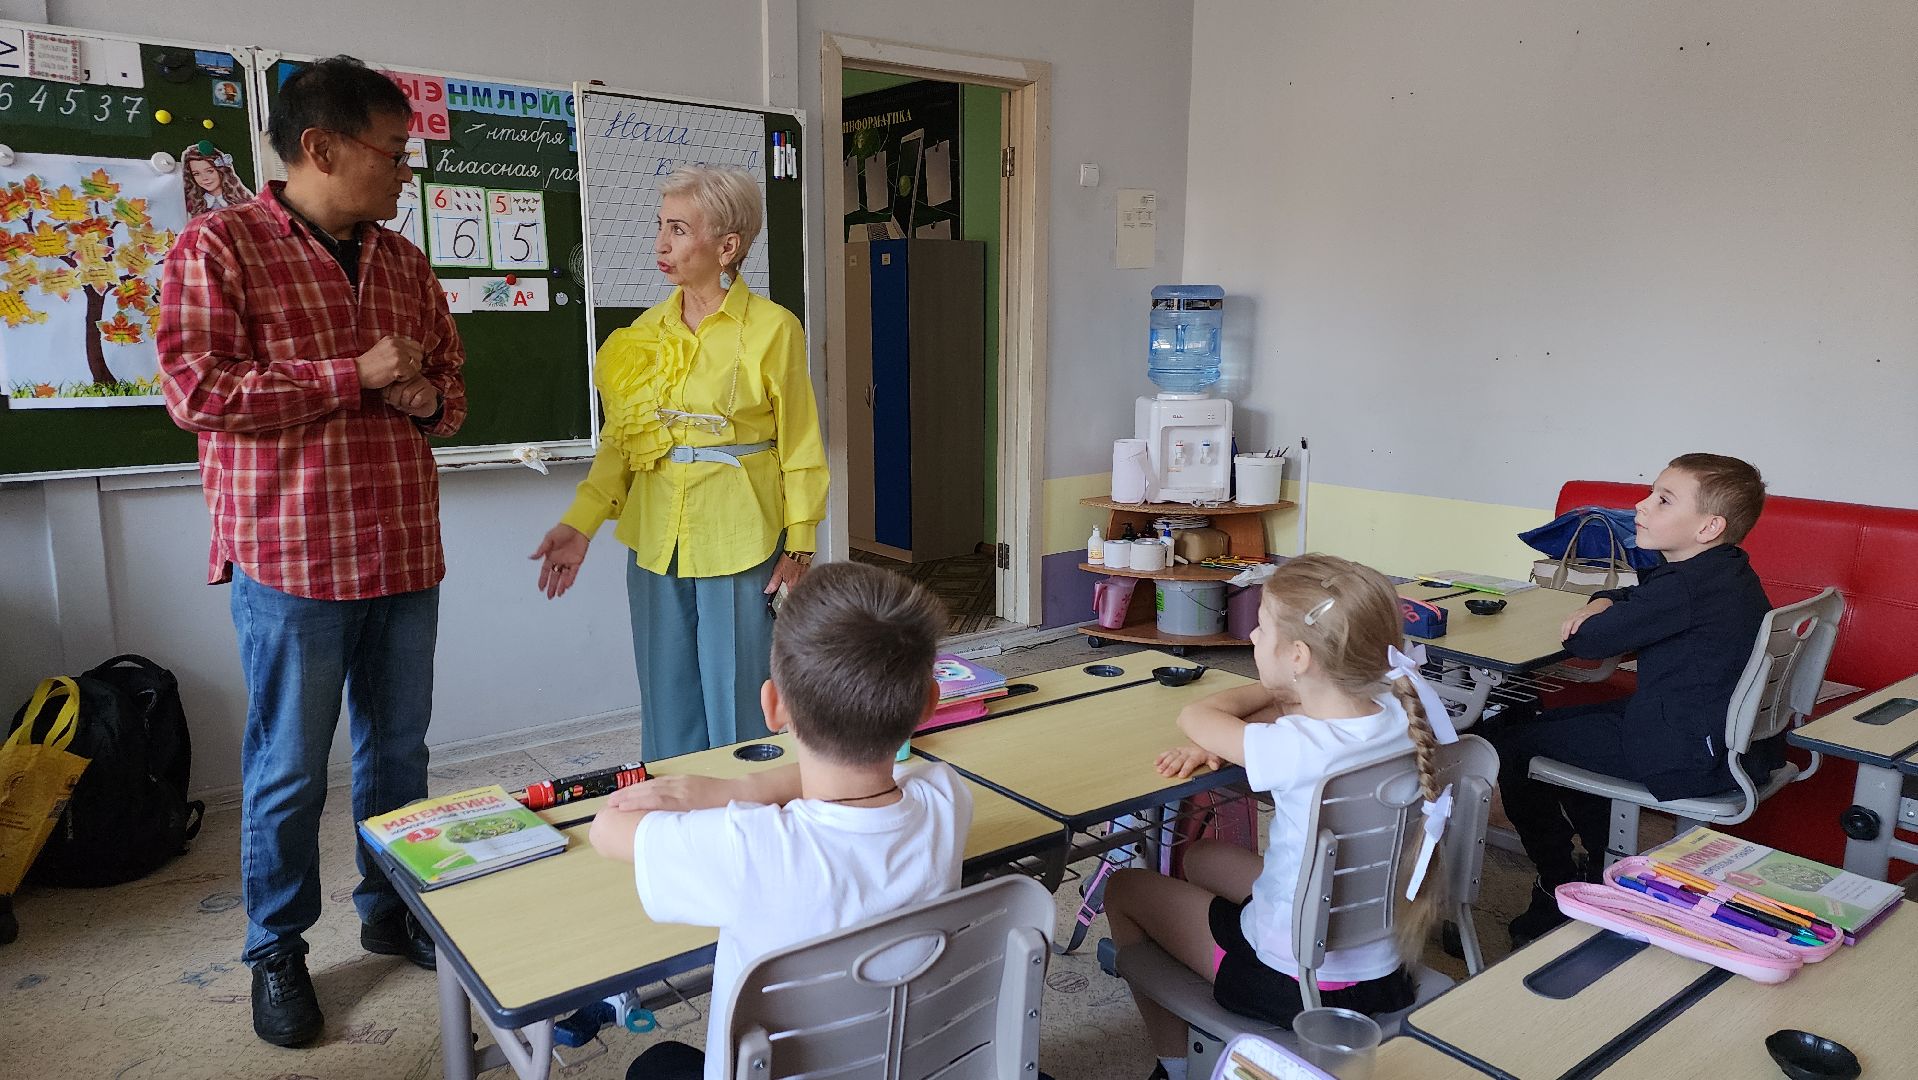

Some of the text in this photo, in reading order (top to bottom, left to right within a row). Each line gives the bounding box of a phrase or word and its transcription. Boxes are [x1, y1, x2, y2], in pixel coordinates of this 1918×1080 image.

[0, 82, 144, 123] 6 4 5 3 7
[842, 108, 912, 134] ИНФОРМАТИКА
[435, 148, 541, 178] Классная
[434, 189, 447, 209] 6
[495, 195, 507, 213] 5
[452, 218, 478, 259] 6
[509, 222, 538, 262] 5
[383, 796, 499, 831] МАТЕМАТИКА
